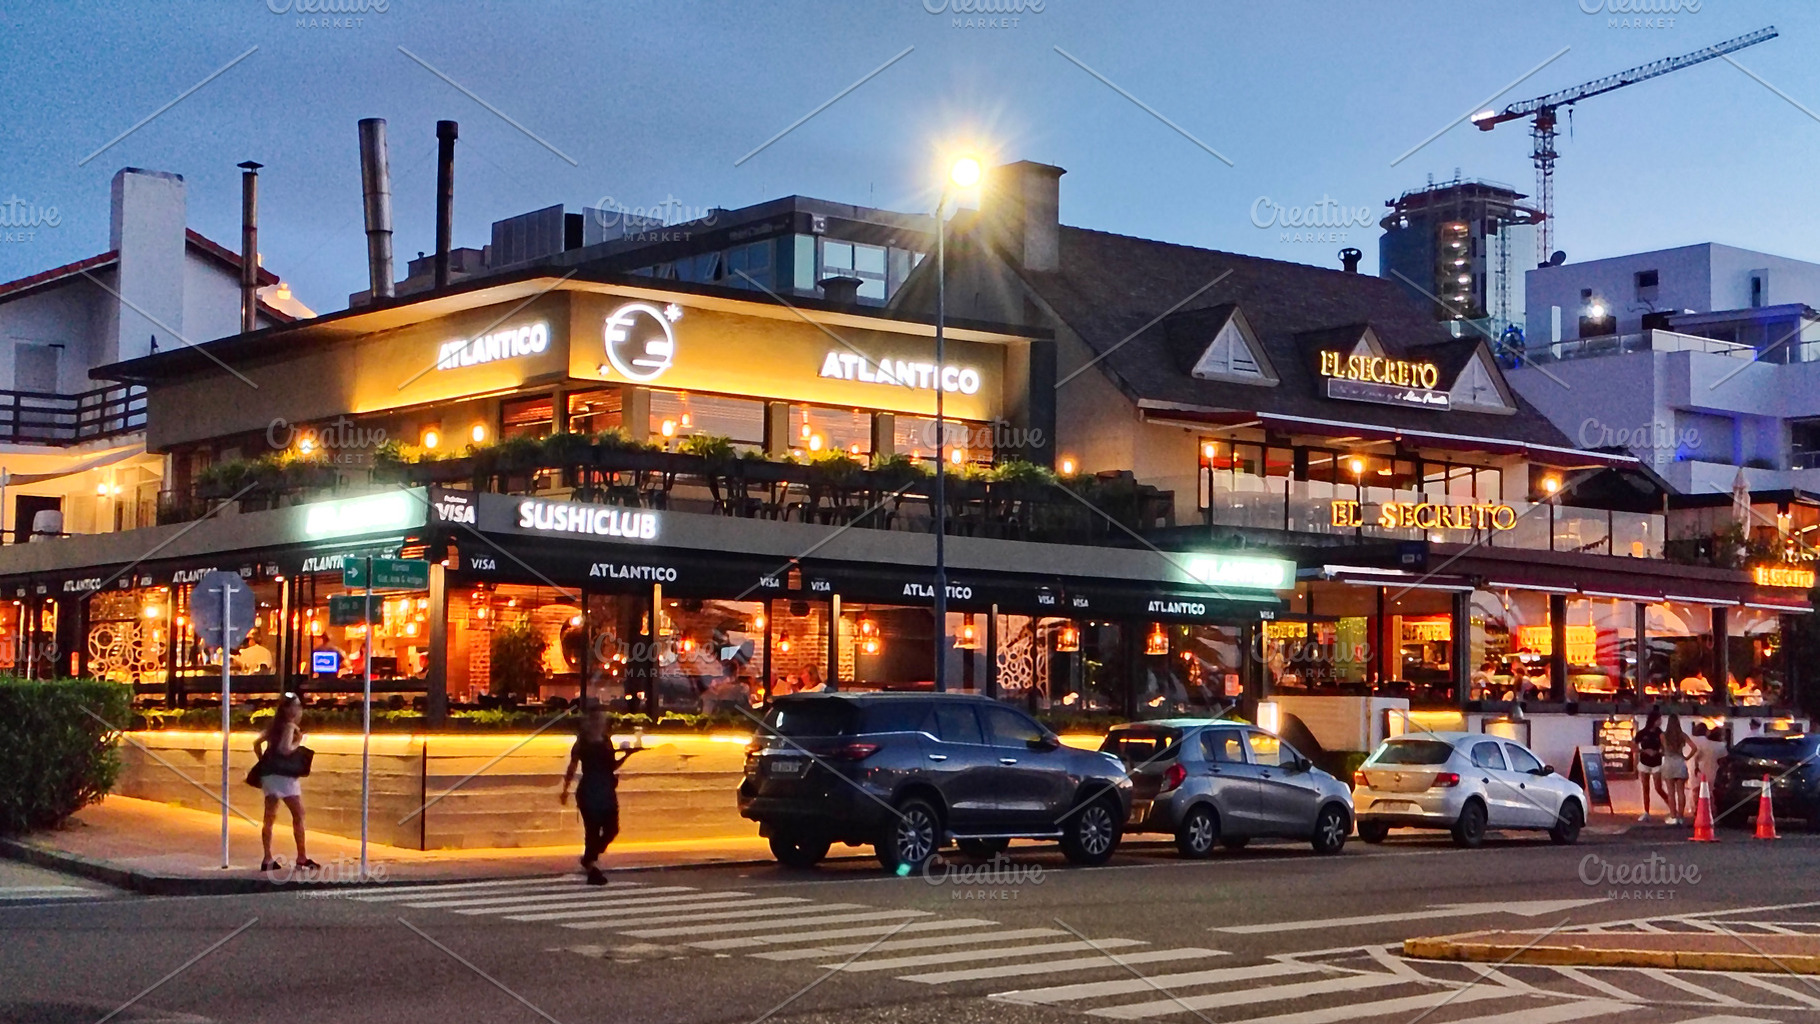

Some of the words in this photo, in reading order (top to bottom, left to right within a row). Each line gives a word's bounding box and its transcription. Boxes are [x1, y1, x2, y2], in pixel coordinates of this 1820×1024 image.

[437, 322, 549, 370] ATLANTICO
[820, 351, 980, 395] ATLANTICO
[1320, 350, 1345, 378] EL
[1347, 354, 1440, 389] SECRETO
[435, 502, 475, 524] VISA
[518, 500, 657, 540] SUSHICLUB
[1331, 499, 1363, 528] EL
[1378, 501, 1518, 531] SECRETO
[470, 558, 496, 570] VISA
[589, 562, 678, 582] ATLANTICO
[759, 576, 780, 588] VISA
[810, 581, 831, 592] VISA
[902, 583, 973, 600] ATLATICO
[1038, 595, 1056, 605] VISA
[1072, 598, 1090, 608] VISA
[1148, 600, 1206, 616] ATLANTICO
